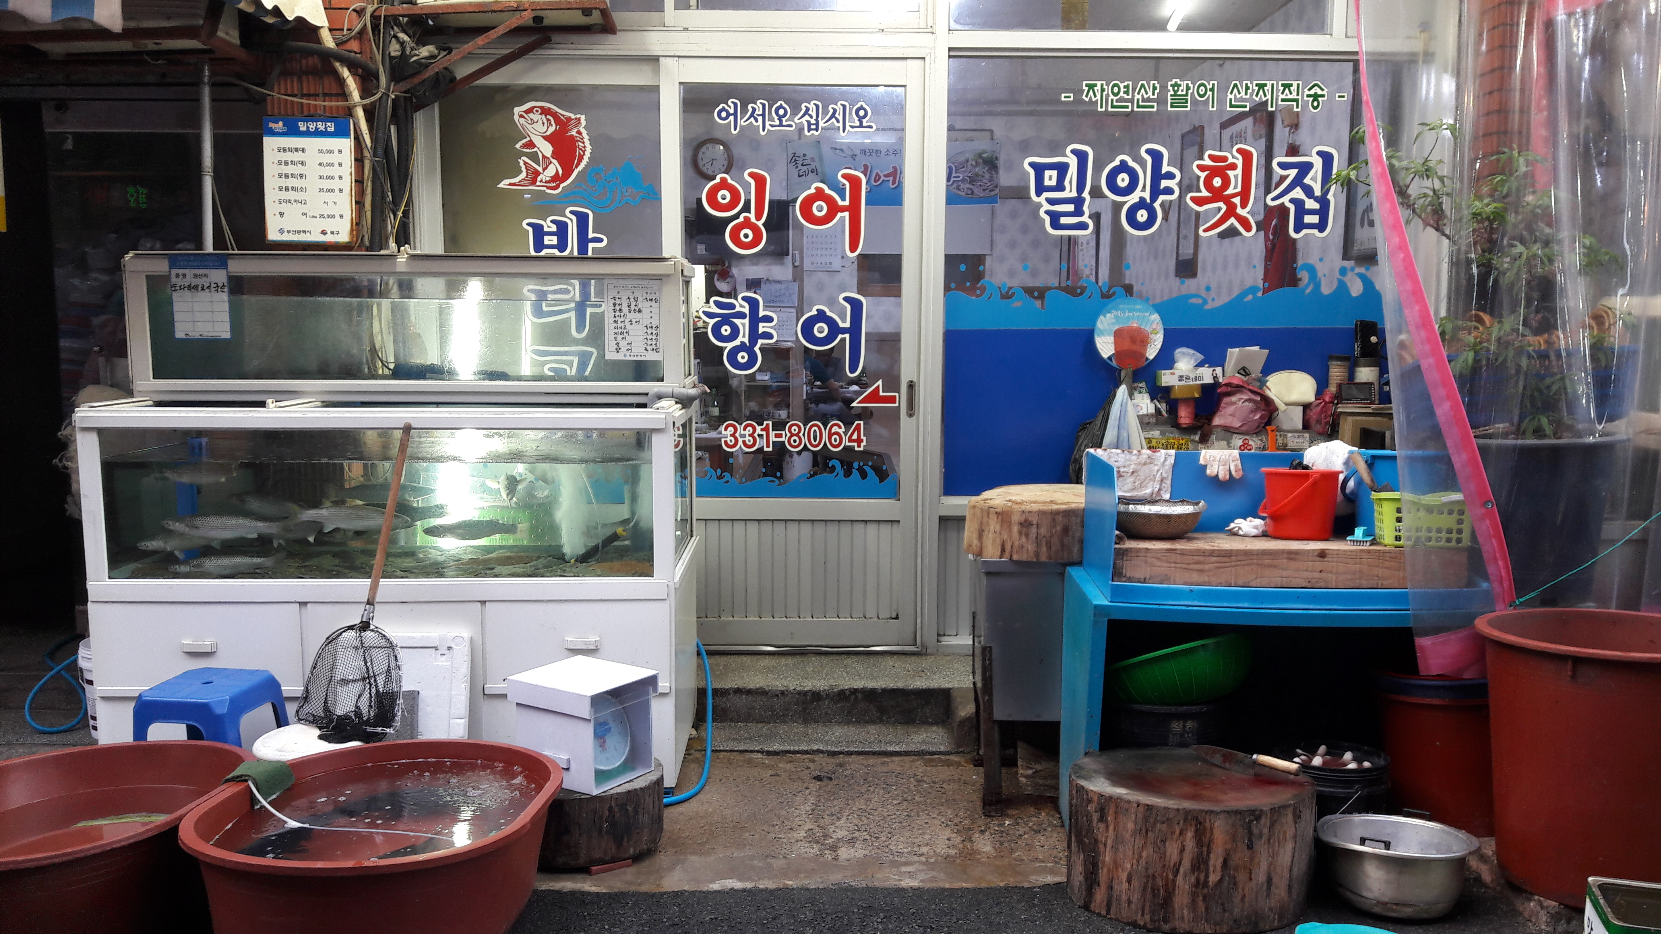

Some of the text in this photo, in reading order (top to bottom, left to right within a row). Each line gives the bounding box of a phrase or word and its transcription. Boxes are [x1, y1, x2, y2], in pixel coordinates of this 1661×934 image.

[1082, 79, 1327, 112] 자연산 활어 산지직송
[298, 121, 335, 132] 밀양횟집
[714, 99, 876, 135] 어서오십시오
[789, 152, 811, 169] 좋은
[859, 148, 902, 157] 깨끗한 소주!
[797, 165, 819, 178] 데이
[1023, 143, 1339, 239] 밀양횟집
[702, 168, 866, 257] 잉어
[699, 291, 867, 377] 향어
[721, 420, 866, 452] 331-8064
